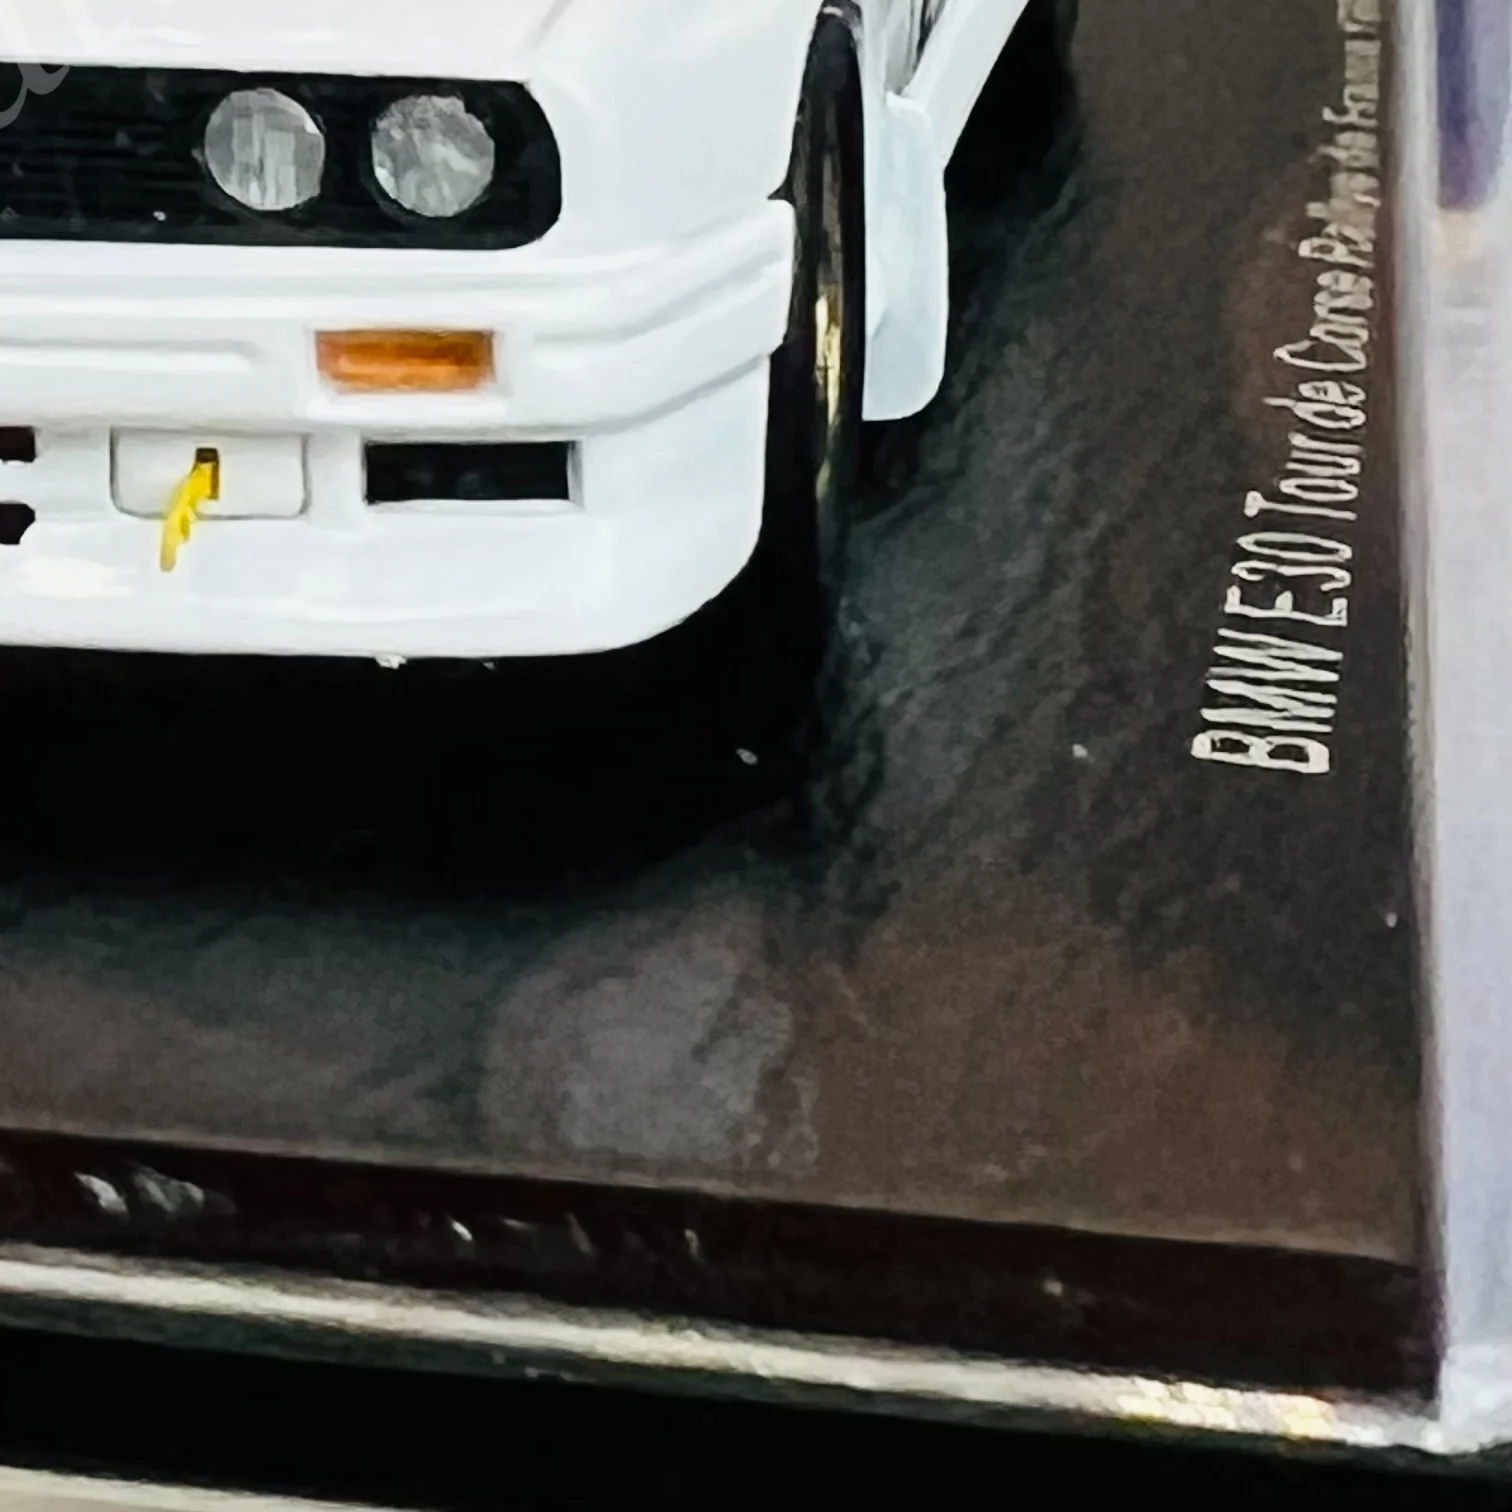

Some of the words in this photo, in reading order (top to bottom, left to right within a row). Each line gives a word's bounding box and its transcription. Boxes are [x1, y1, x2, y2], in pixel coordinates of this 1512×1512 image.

[1262, 378, 1368, 430] de
[1244, 432, 1364, 522] Tour
[1224, 531, 1354, 627] E30
[1190, 626, 1343, 775] BMW
